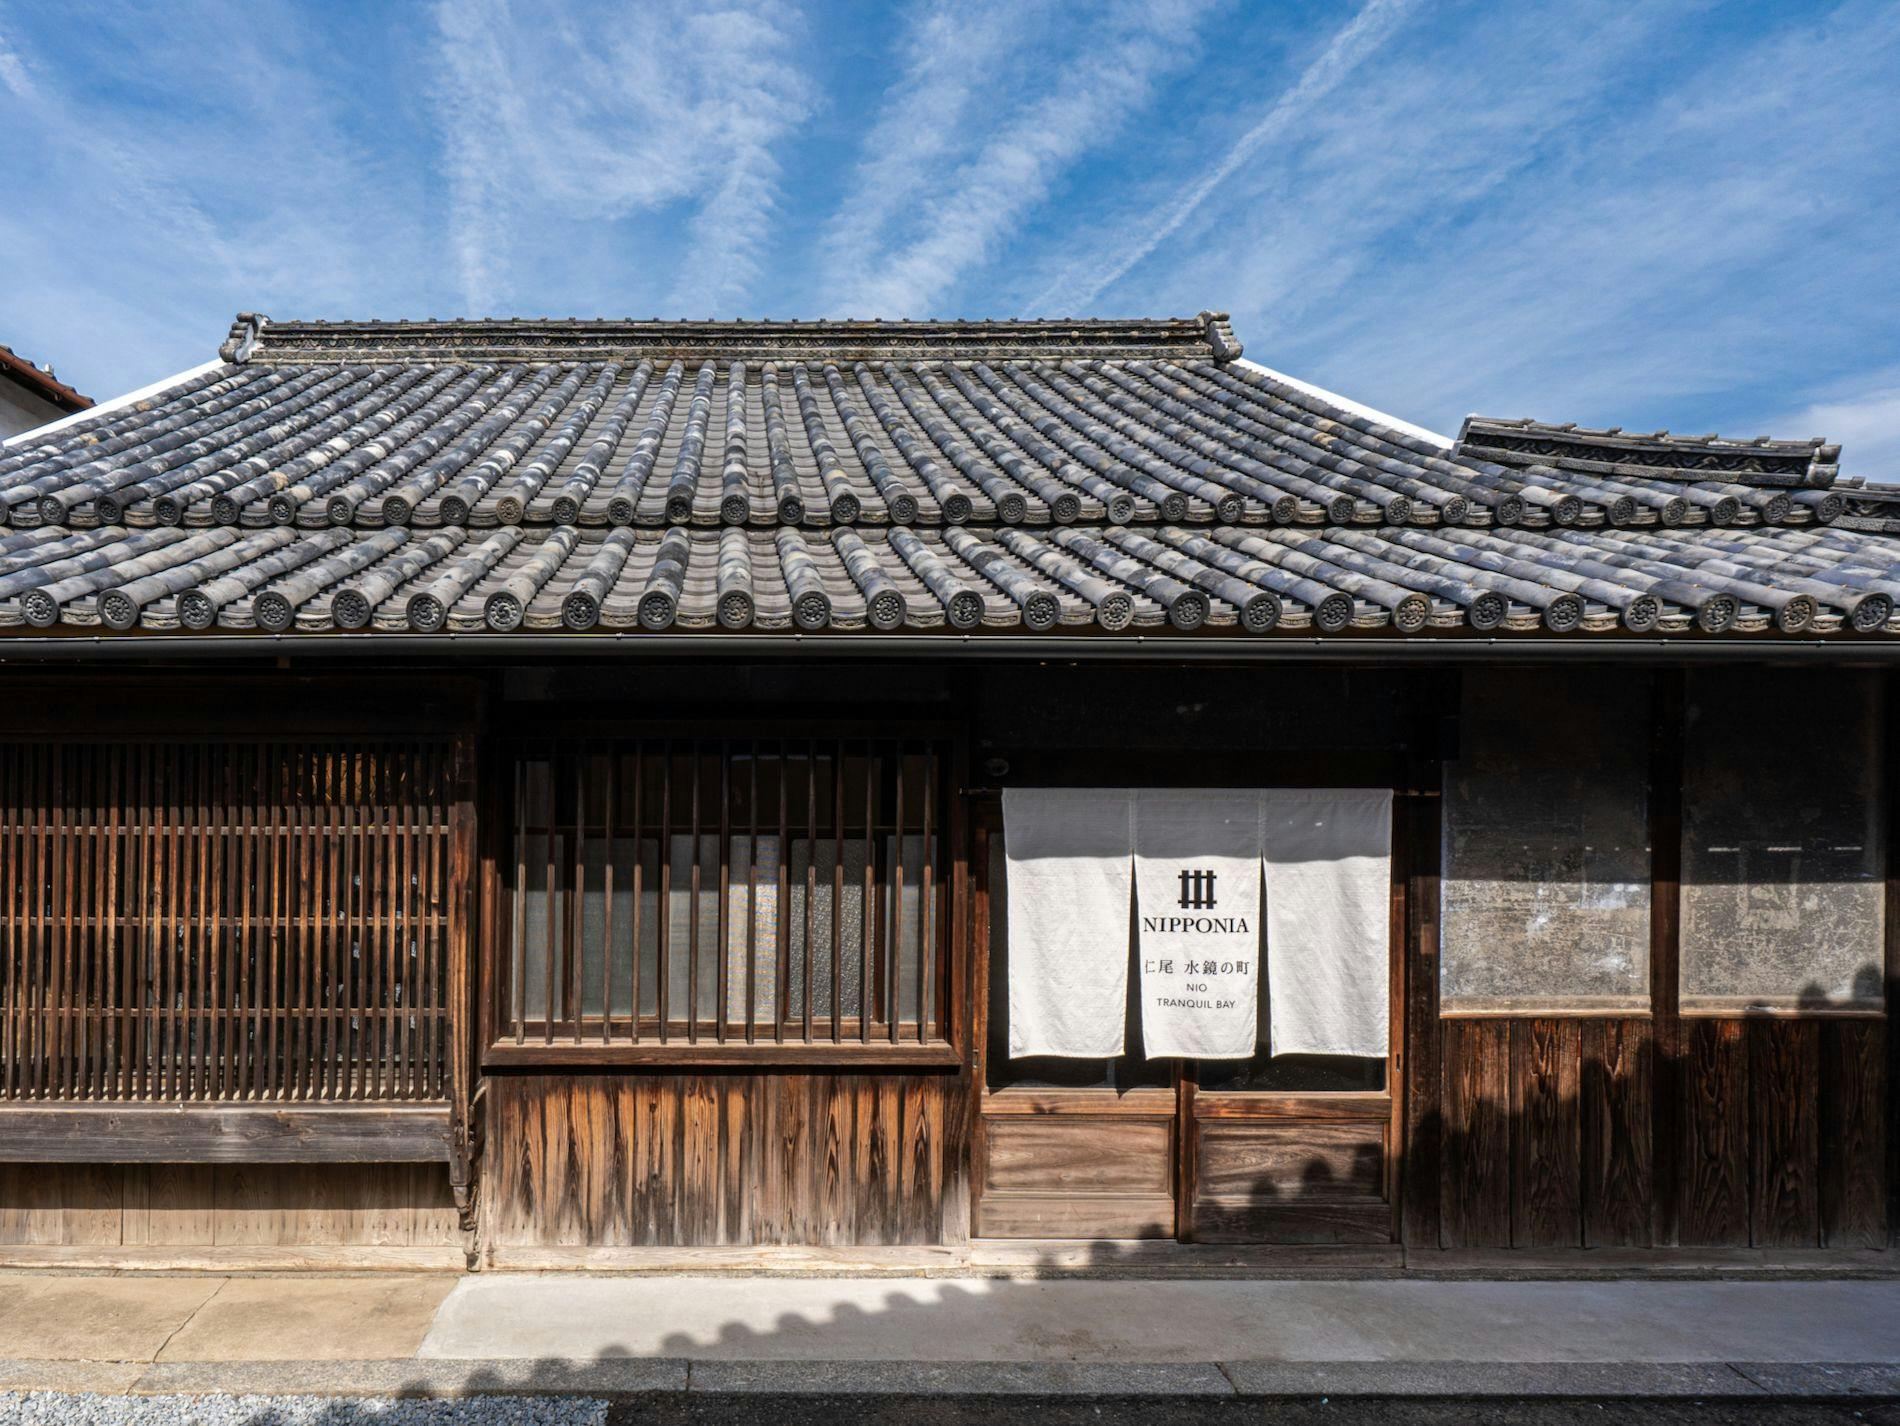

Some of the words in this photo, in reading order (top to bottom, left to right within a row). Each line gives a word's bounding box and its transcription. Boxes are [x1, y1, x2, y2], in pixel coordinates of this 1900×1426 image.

[1143, 917, 1249, 933] NIPPONIA
[1184, 959, 1250, 975] 水鏡の町
[1186, 983, 1208, 992] NIO
[1157, 998, 1212, 1009] TRANQUIL
[1216, 1000, 1236, 1009] BAY
